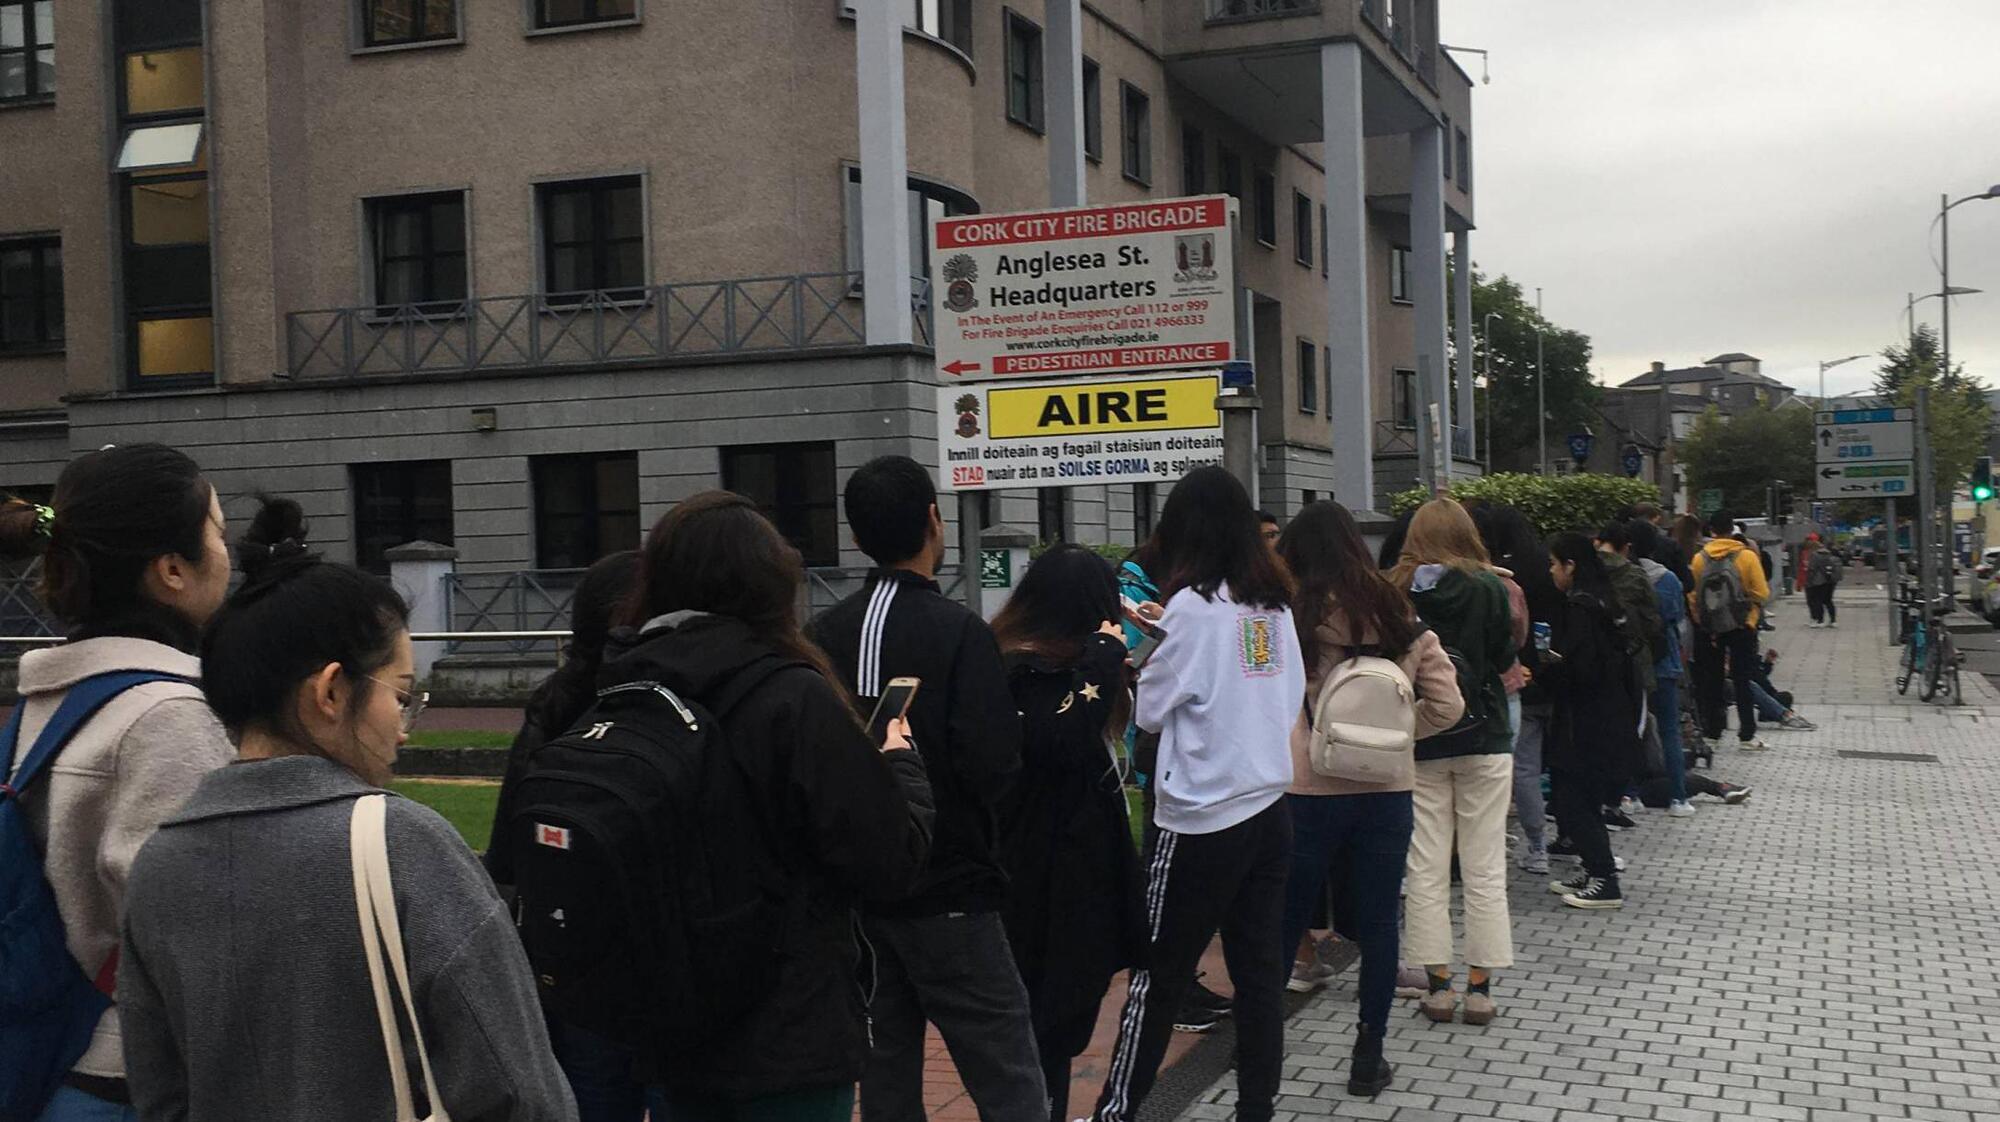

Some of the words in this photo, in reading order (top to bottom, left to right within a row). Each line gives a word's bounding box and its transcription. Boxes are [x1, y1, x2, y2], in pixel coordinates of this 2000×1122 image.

[954, 222, 1010, 243] CORK
[1013, 218, 1058, 238] CITY
[1064, 214, 1108, 234] FIRE
[1113, 205, 1208, 230] BRIGADE
[996, 250, 1106, 278] Anglesea
[1118, 245, 1150, 267] St.
[990, 280, 1156, 308] Headquarters
[957, 316, 969, 326] In
[970, 315, 990, 325] The
[993, 313, 1024, 324] Event
[1026, 311, 1038, 322] of
[1041, 311, 1056, 320] An
[1058, 307, 1121, 320] Emergency
[1123, 304, 1145, 316] Call
[1147, 303, 1169, 314] 112
[1171, 303, 1184, 312] or
[1186, 300, 1209, 311] 999
[962, 329, 980, 340] For
[982, 328, 1004, 339] Fire
[1005, 324, 1049, 337] Brigade
[1051, 321, 1104, 335] Enquiries
[1106, 319, 1128, 331] Call
[1130, 318, 1151, 329] 021
[1154, 314, 1205, 328] 4966333
[1006, 332, 1159, 350] www.corkcityfirebrigade.ie
[1006, 352, 1113, 371] PEDESTRIAN
[1121, 345, 1216, 364] ENTRANCE
[1037, 389, 1168, 427] AIRE
[947, 447, 979, 461] Innill
[1042, 445, 1059, 459] ag
[952, 466, 984, 483] STAD
[986, 465, 1016, 481] nuair
[1019, 465, 1038, 479] ata
[1041, 465, 1055, 478] na
[1058, 459, 1102, 477] SOILSE
[1105, 457, 1150, 475] GORMA
[1153, 460, 1168, 476] ag
